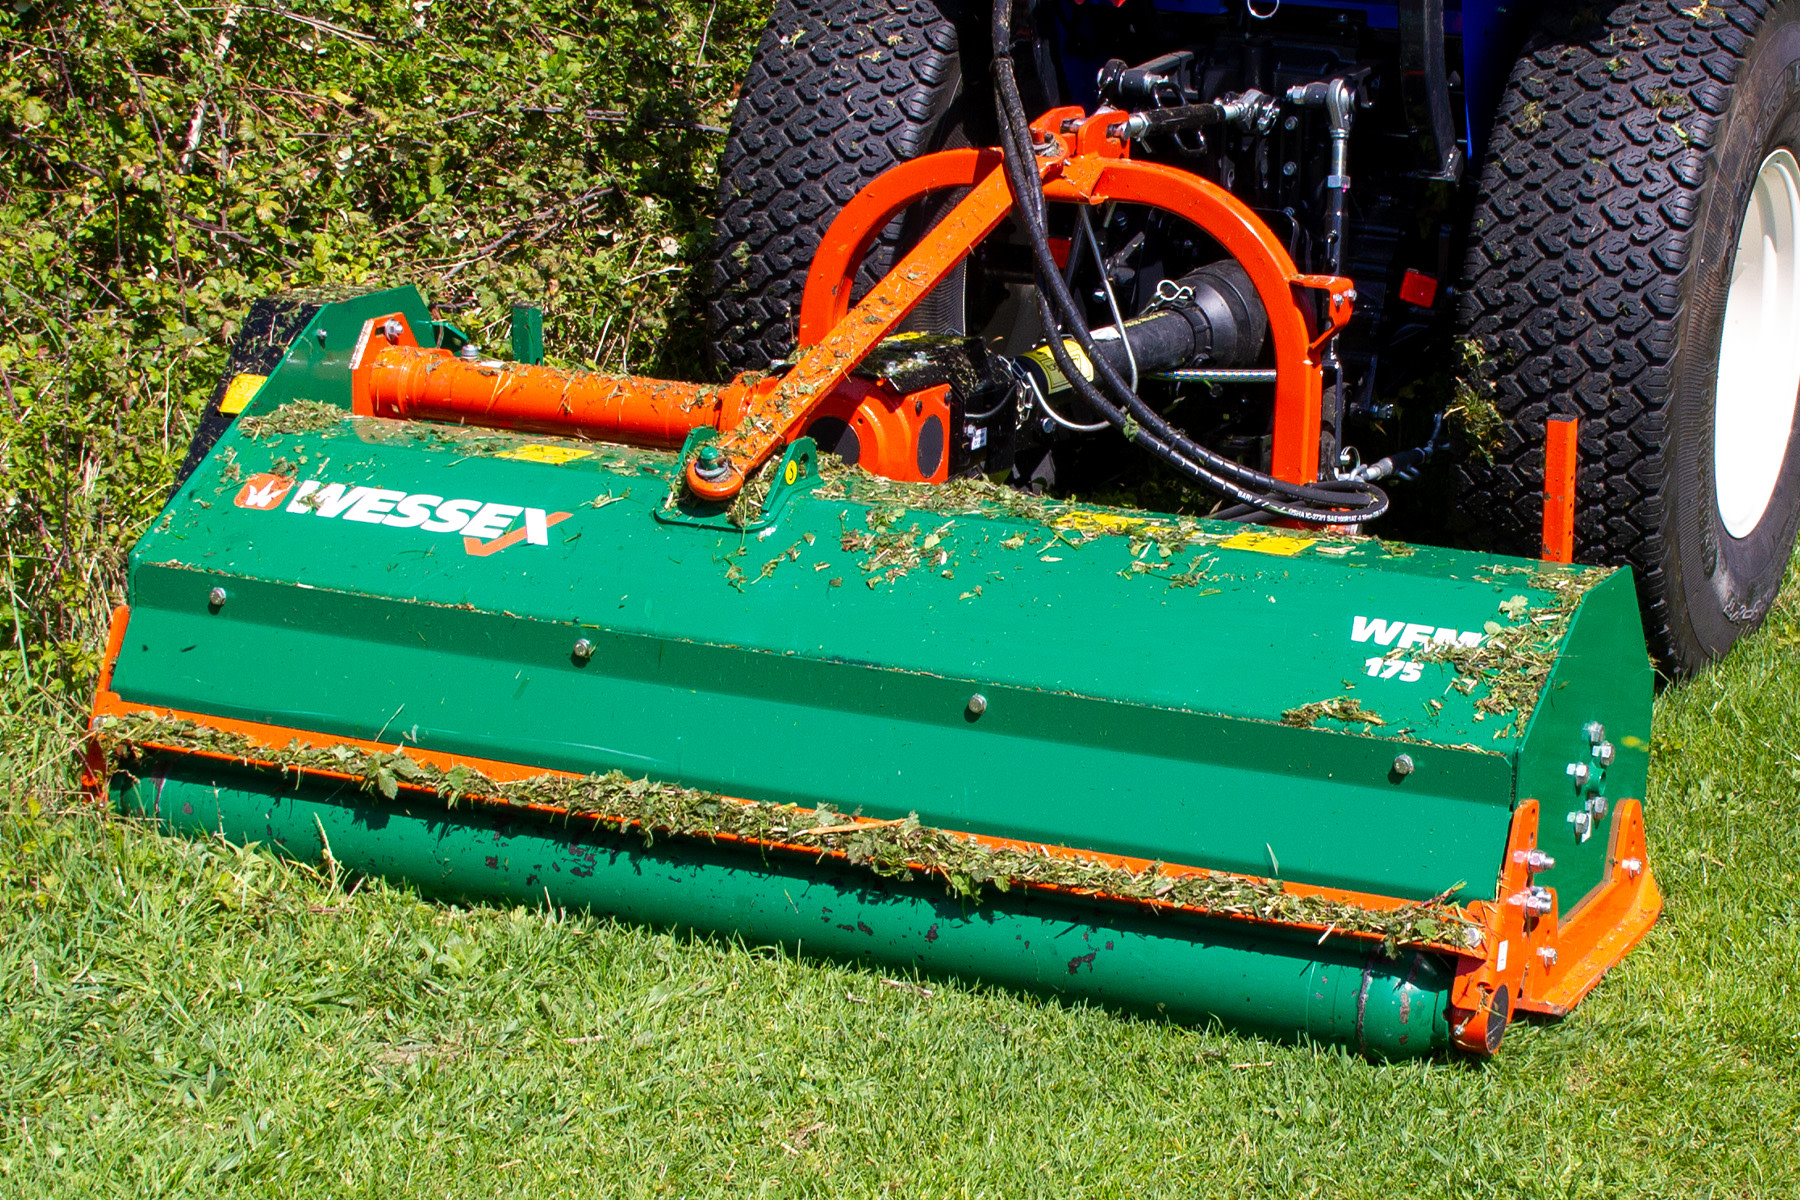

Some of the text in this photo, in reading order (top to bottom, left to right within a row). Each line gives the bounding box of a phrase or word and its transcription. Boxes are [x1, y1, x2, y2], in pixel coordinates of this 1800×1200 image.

[286, 479, 574, 557] WESSEX
[1351, 615, 1481, 652] WFM
[1364, 656, 1425, 683] 175
